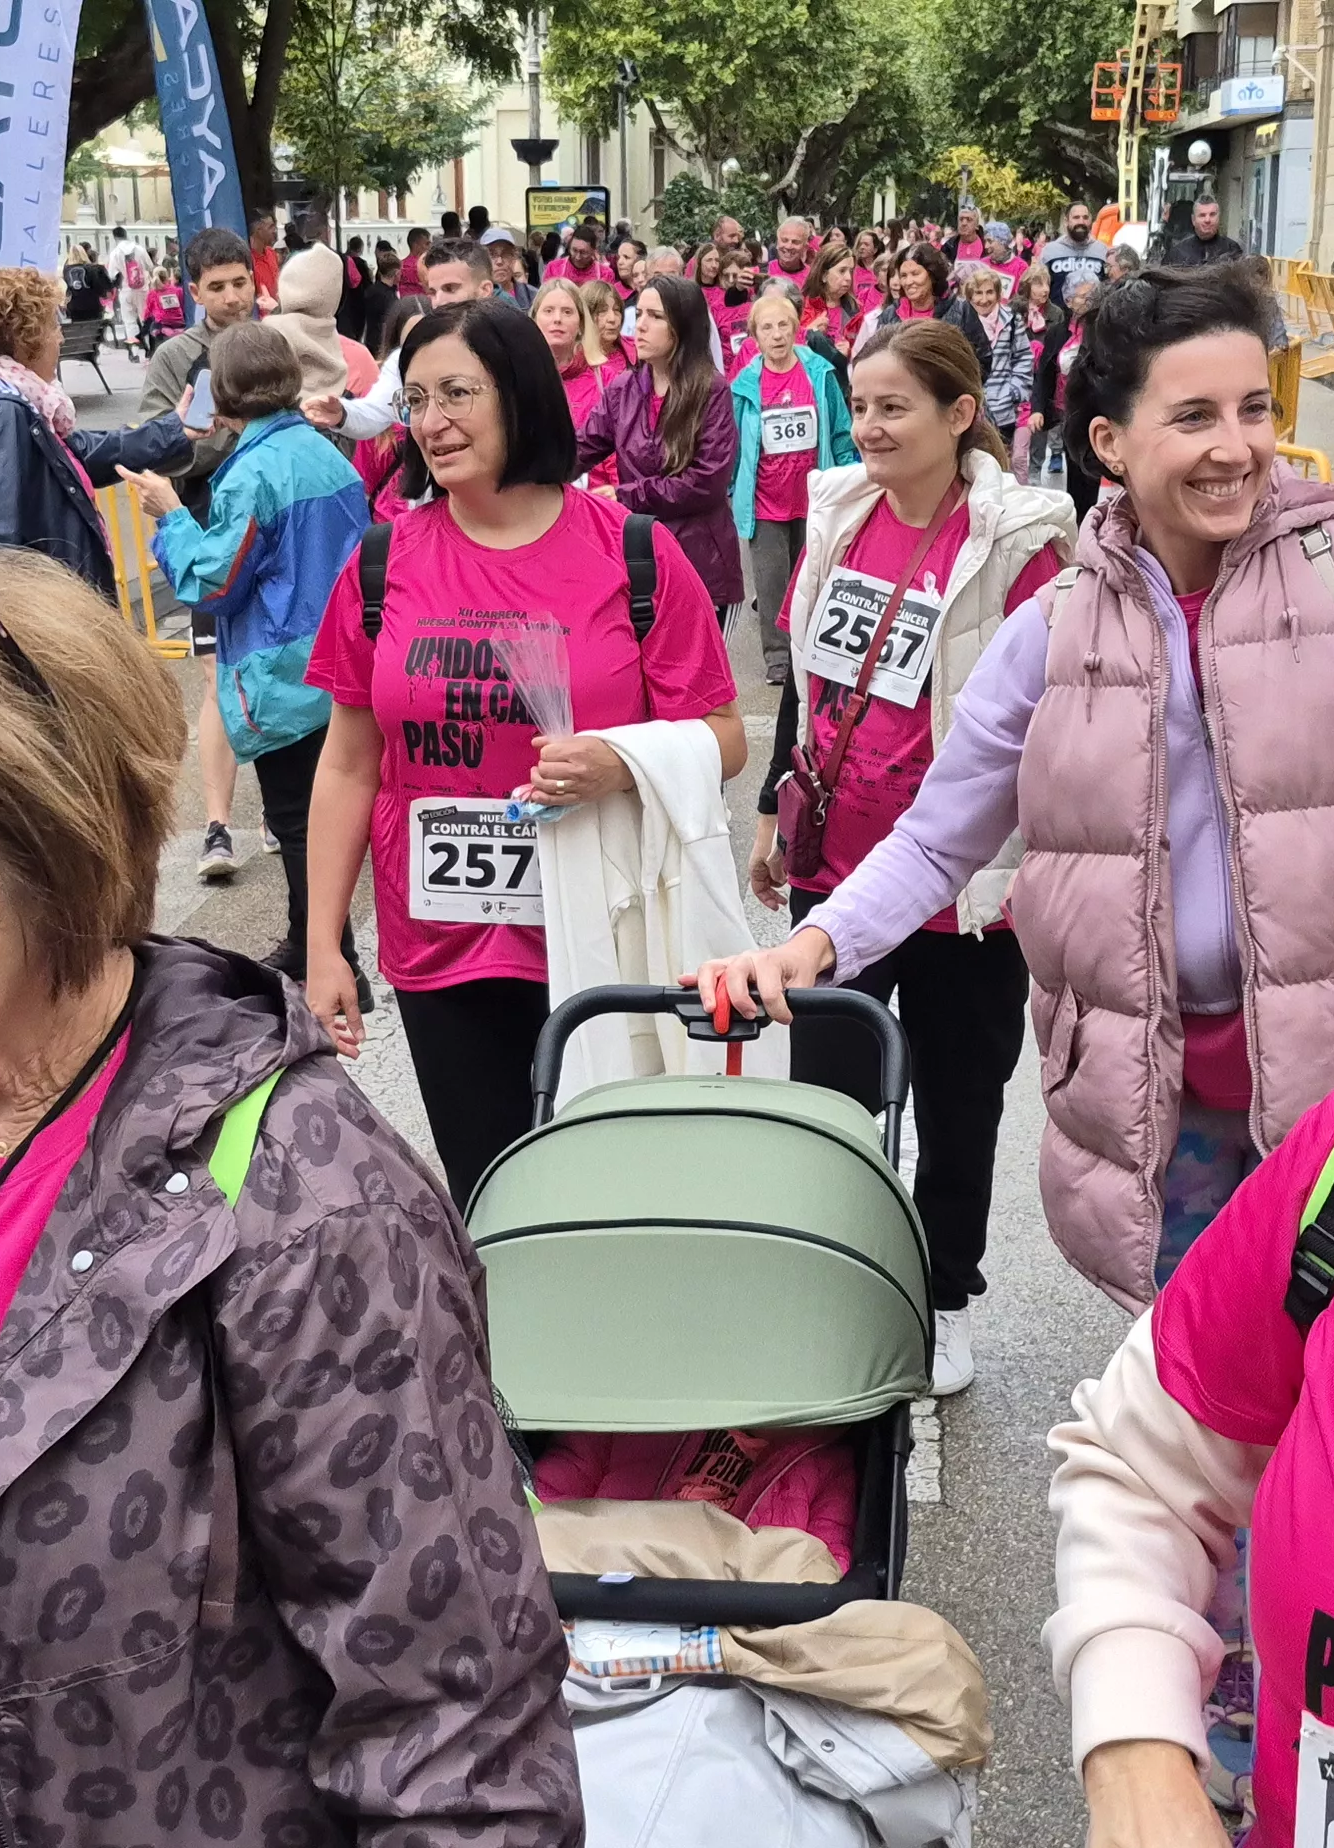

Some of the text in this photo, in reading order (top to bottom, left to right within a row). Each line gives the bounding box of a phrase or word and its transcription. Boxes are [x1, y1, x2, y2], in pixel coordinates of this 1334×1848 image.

[20, 7, 61, 268] TALLERES
[1051, 257, 1102, 273] adidas
[773, 422, 806, 441] 368
[836, 590, 879, 613] CONTRA
[417, 618, 456, 628] HUESCA
[458, 607, 528, 620] XII CARRERA
[445, 682, 483, 722] EN
[402, 720, 484, 769] PASO
[431, 822, 490, 836] CONTRA
[493, 825, 509, 836] EL
[428, 842, 541, 889] 257
